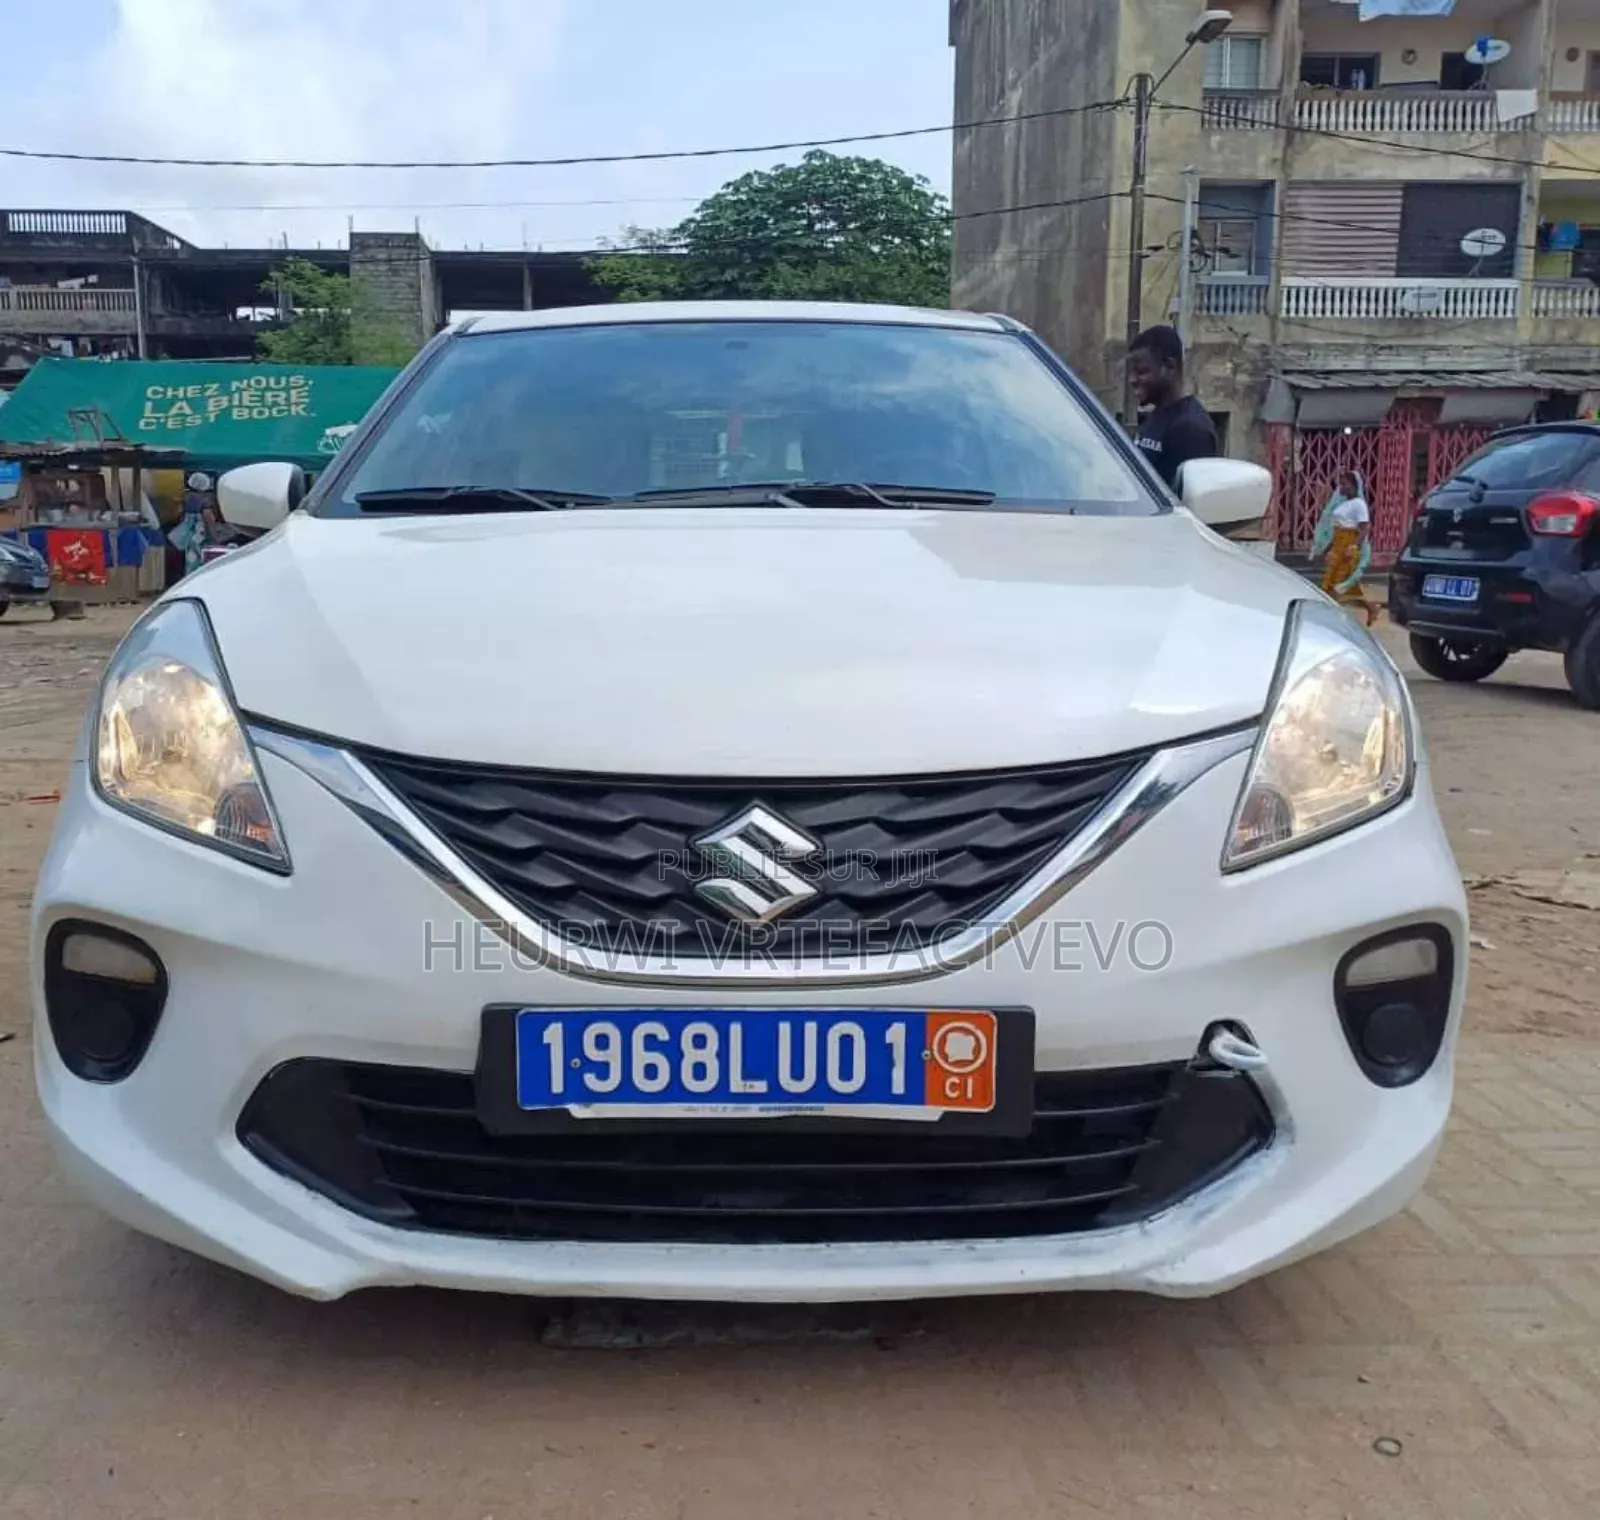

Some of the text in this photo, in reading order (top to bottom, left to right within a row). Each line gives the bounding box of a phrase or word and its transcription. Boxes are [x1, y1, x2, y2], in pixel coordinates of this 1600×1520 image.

[146, 383, 221, 400] CHEZ
[143, 400, 195, 417] LA
[138, 411, 218, 430] C'EST
[945, 1076, 973, 1098] CI
